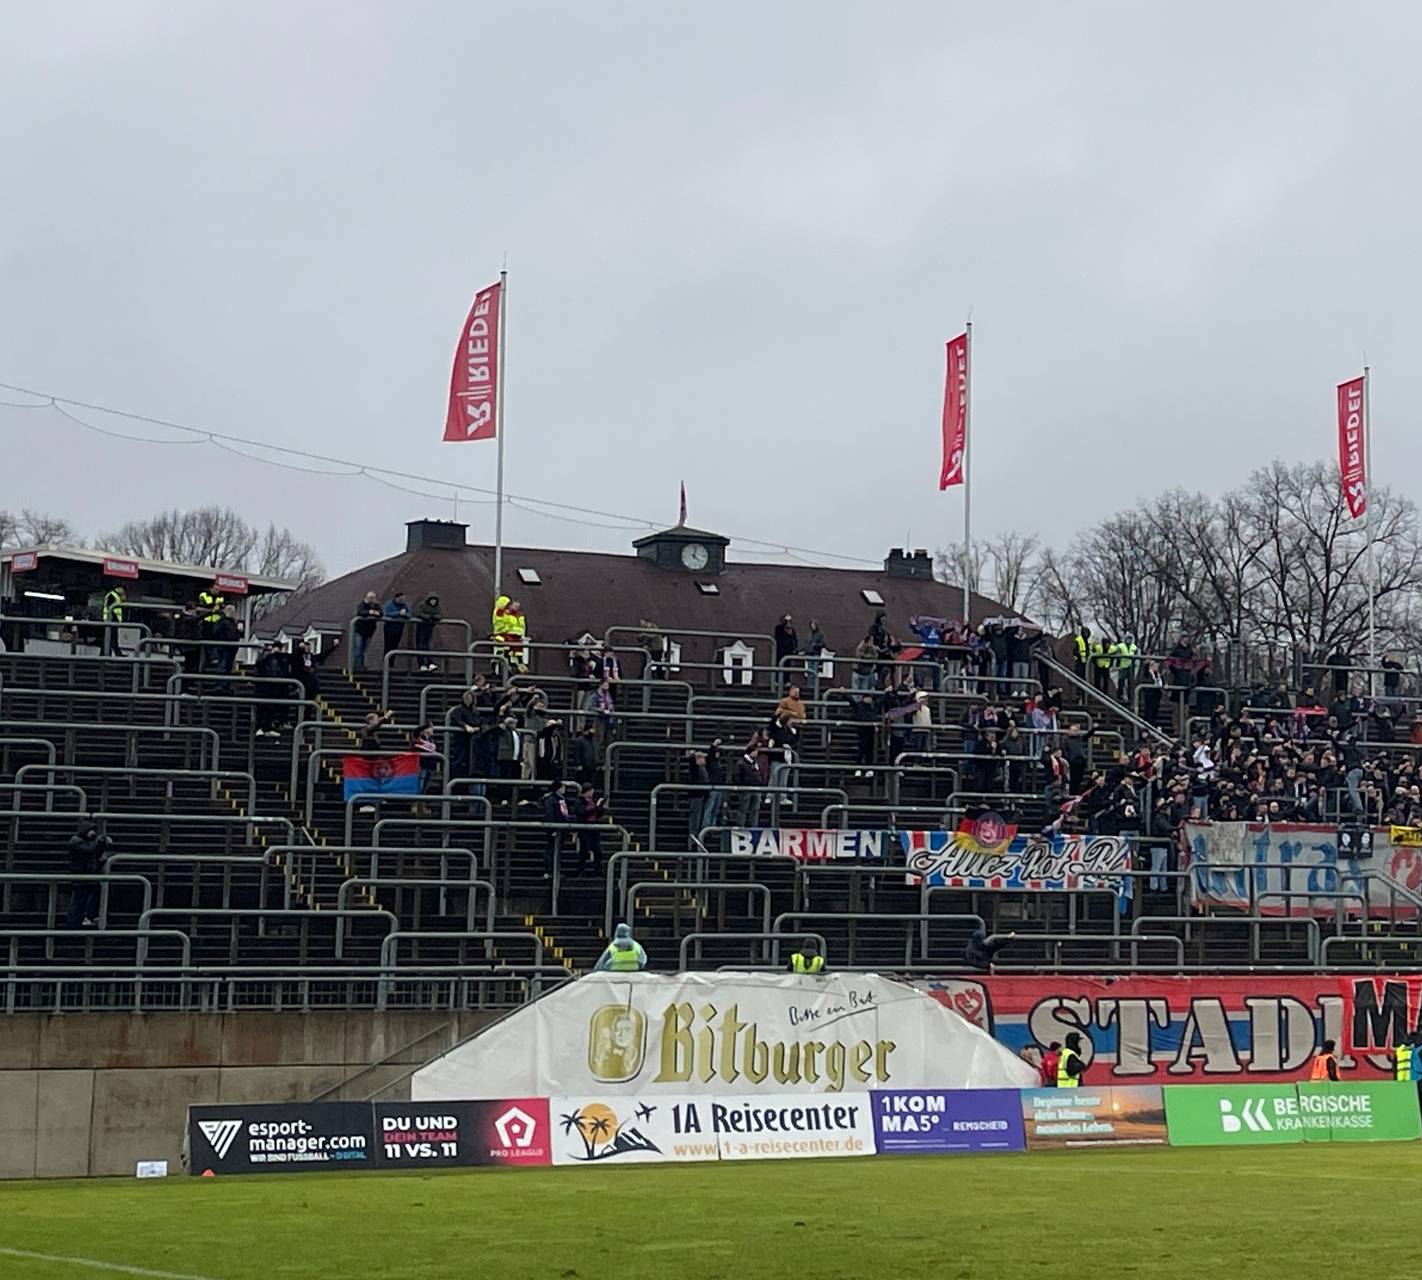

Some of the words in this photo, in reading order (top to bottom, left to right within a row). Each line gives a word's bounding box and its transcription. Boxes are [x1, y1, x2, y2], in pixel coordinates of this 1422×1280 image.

[731, 829, 882, 858] BARMEN
[652, 1002, 896, 1092] Bitburger
[882, 1095, 946, 1113] 1KOM
[1273, 1095, 1372, 1115] BERGISCHE
[383, 1117, 410, 1131] DU
[415, 1116, 458, 1130] UND
[672, 1103, 701, 1134] 1A
[712, 1103, 859, 1133] Reisecenter
[953, 1120, 1008, 1132] REMSCHEID
[1276, 1115, 1373, 1130] KRANKENKASSE
[249, 1119, 312, 1138] esport-
[383, 1132, 417, 1143] DEIN
[421, 1131, 457, 1142] TEAM
[250, 1134, 366, 1152] manager.com
[384, 1144, 401, 1158] 11
[405, 1143, 438, 1158] VS.
[442, 1142, 457, 1157] 11
[673, 1136, 864, 1156] www1-a-reisecenter.de
[490, 1150, 509, 1158] PRO
[510, 1149, 544, 1157] LEAGUE
